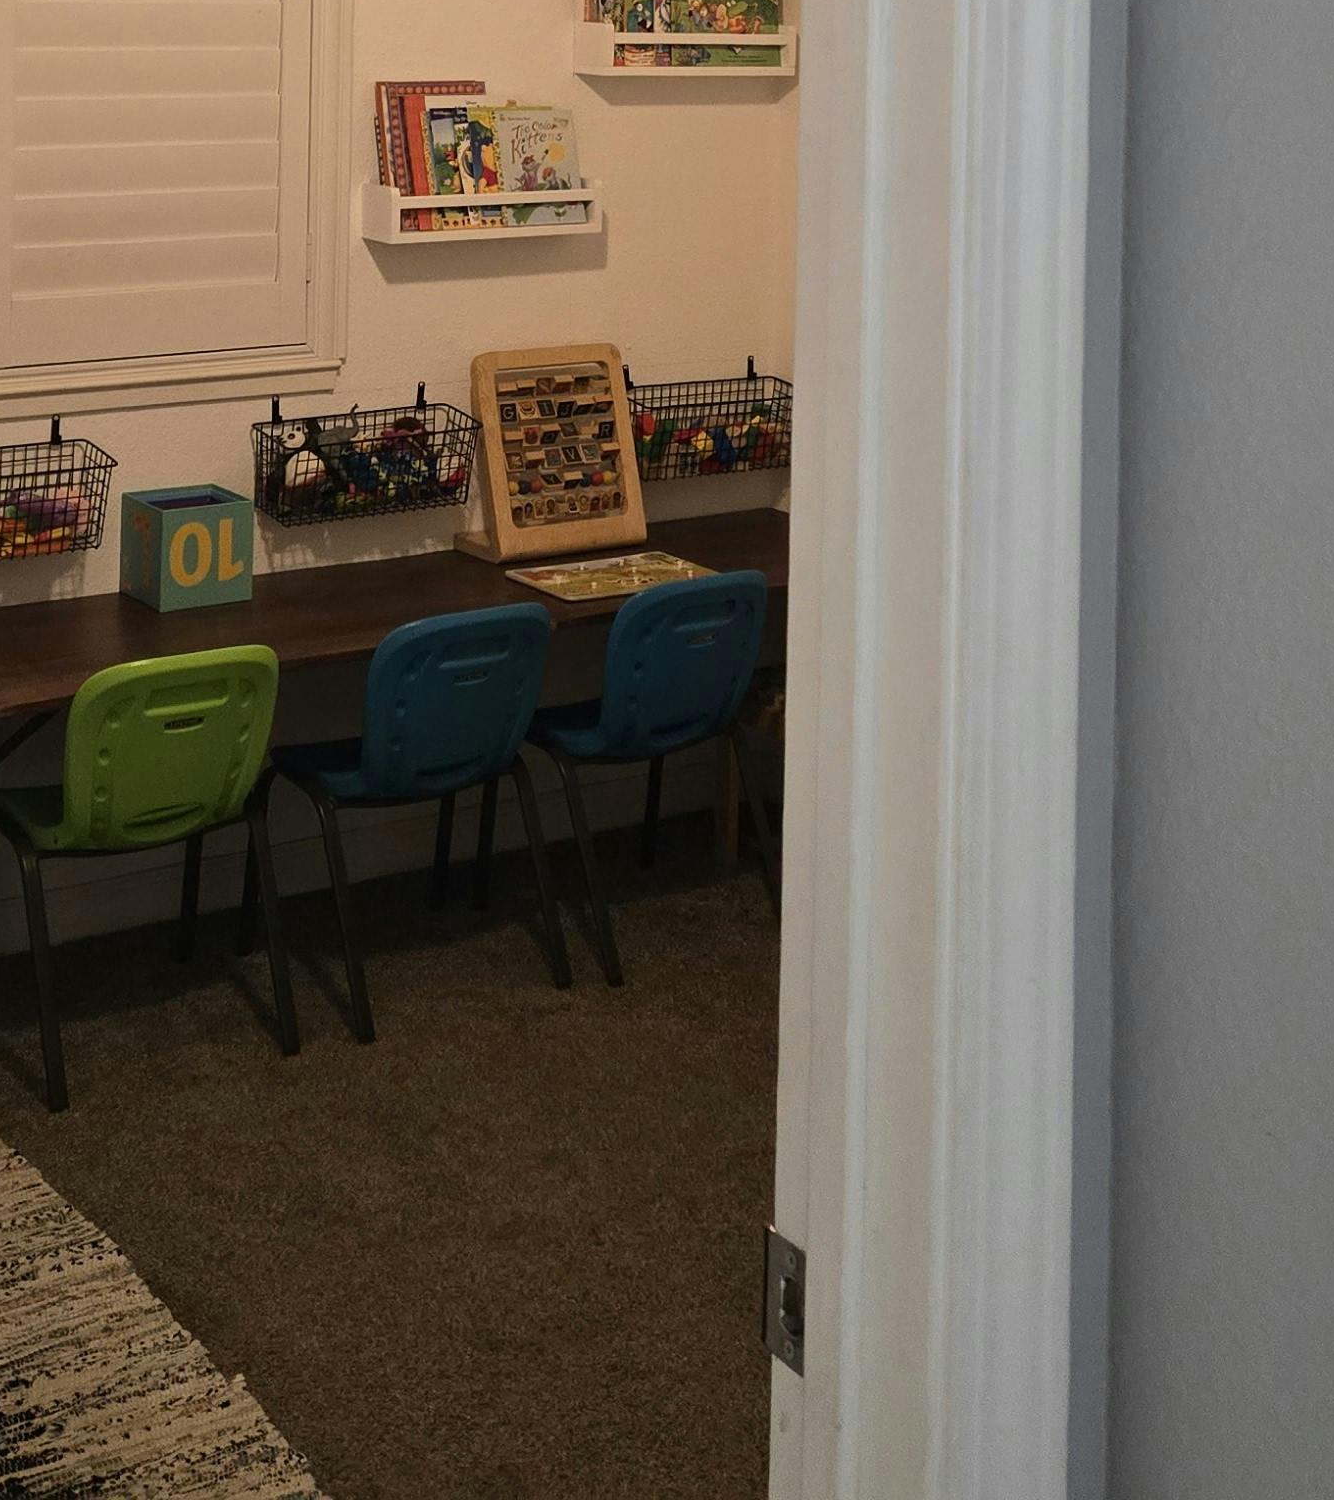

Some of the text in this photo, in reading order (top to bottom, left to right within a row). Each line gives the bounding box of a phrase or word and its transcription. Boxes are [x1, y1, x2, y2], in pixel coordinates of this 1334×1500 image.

[502, 406, 515, 420] G
[600, 423, 611, 437] R
[565, 449, 575, 460] V
